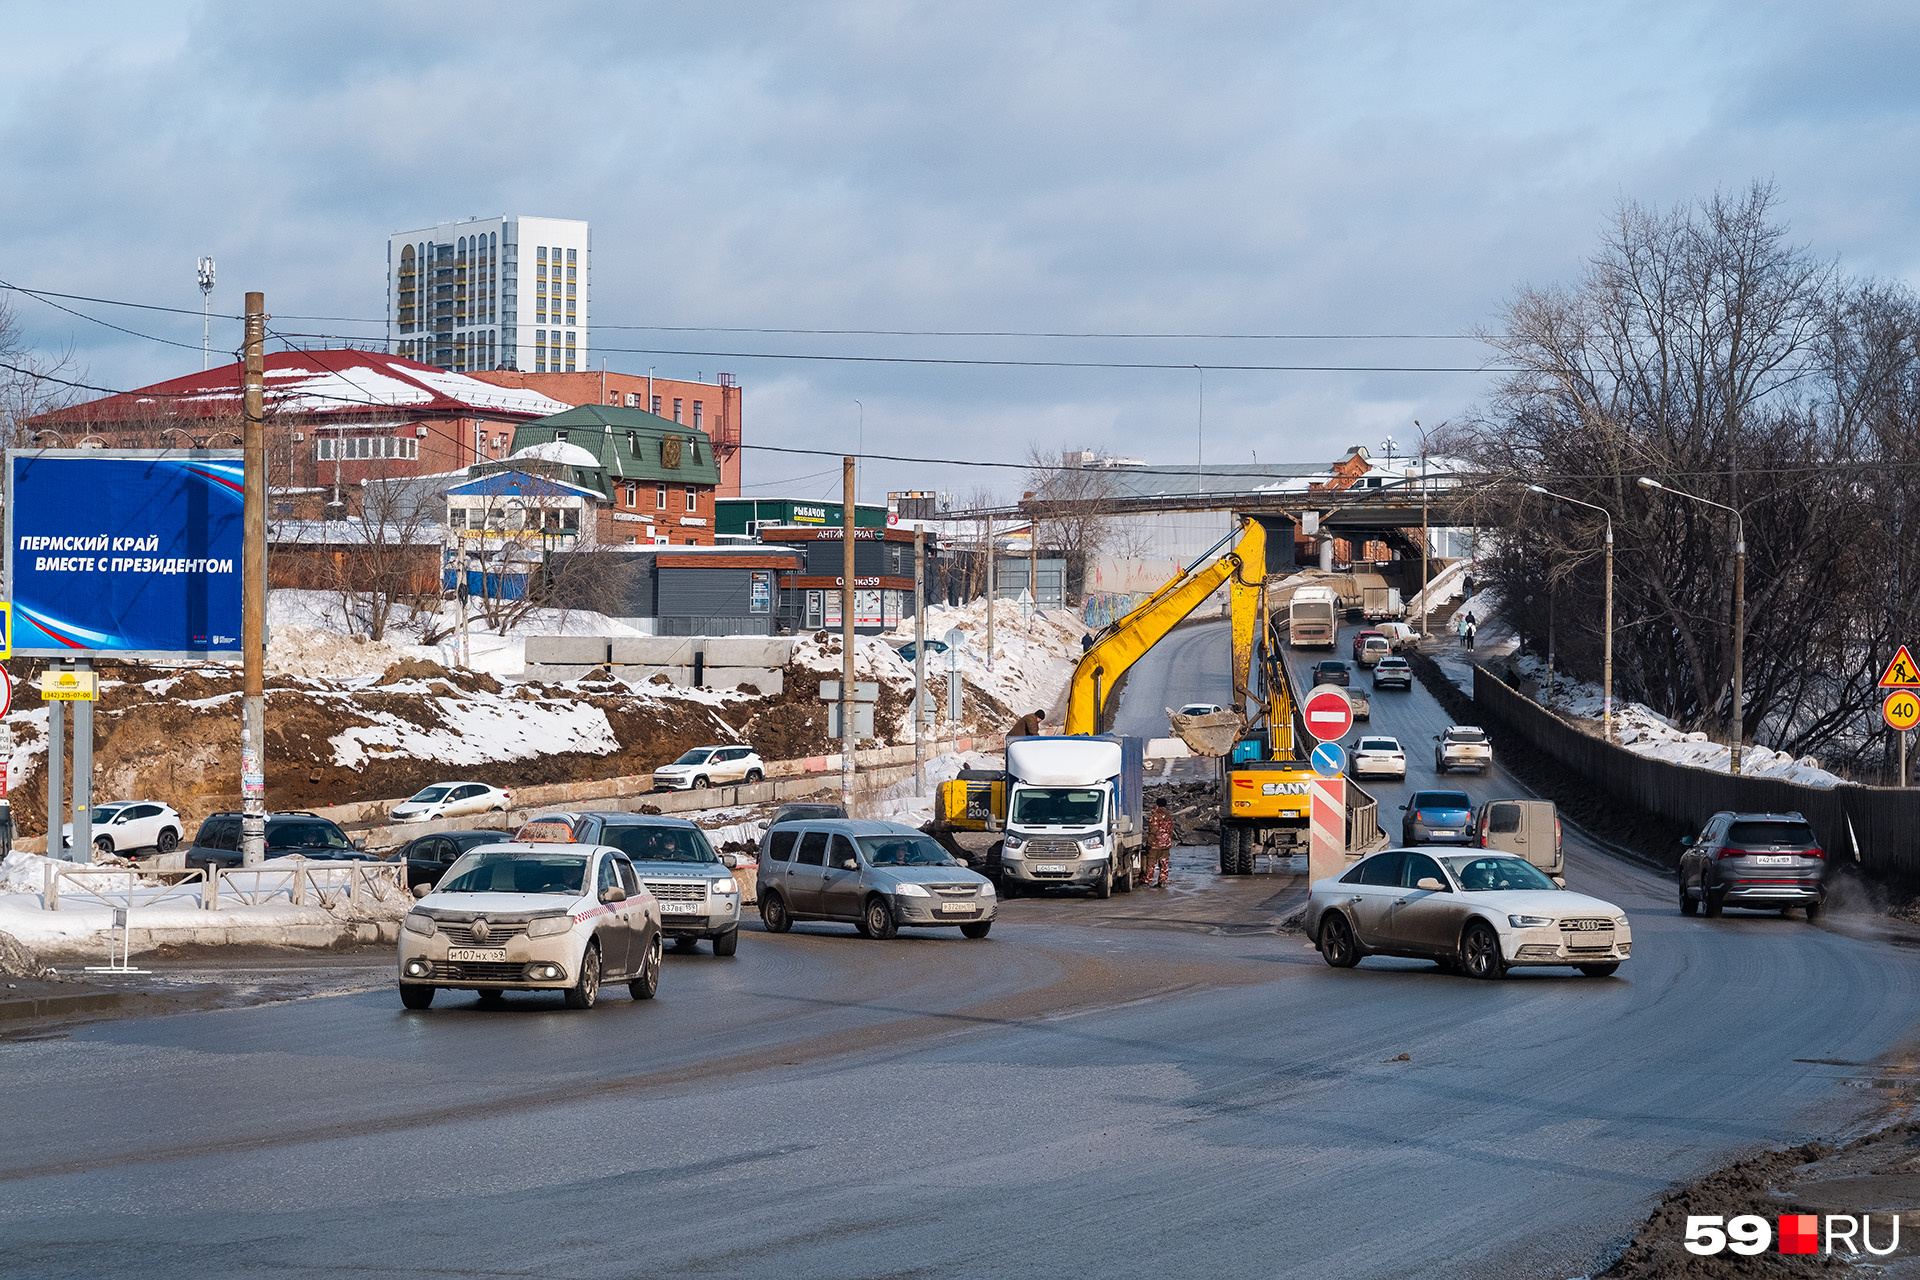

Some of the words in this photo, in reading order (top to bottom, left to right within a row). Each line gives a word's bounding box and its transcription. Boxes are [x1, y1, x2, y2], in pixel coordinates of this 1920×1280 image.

[794, 506, 825, 517] РЫБАЧОК
[817, 530, 873, 539] АНТИКРИАТ
[19, 533, 109, 551] ПЕРМСКИЙ
[112, 534, 159, 552] КРАЙ
[35, 556, 95, 572] ВМЕСТЕ
[97, 557, 108, 572] С
[110, 558, 233, 575] ПРЕЗИДЕНТОМ
[835, 576, 880, 586] Спка59
[1891, 702, 1914, 718] 40
[1262, 782, 1311, 796] SANY
[968, 800, 980, 808] PC
[968, 808, 990, 817] 200
